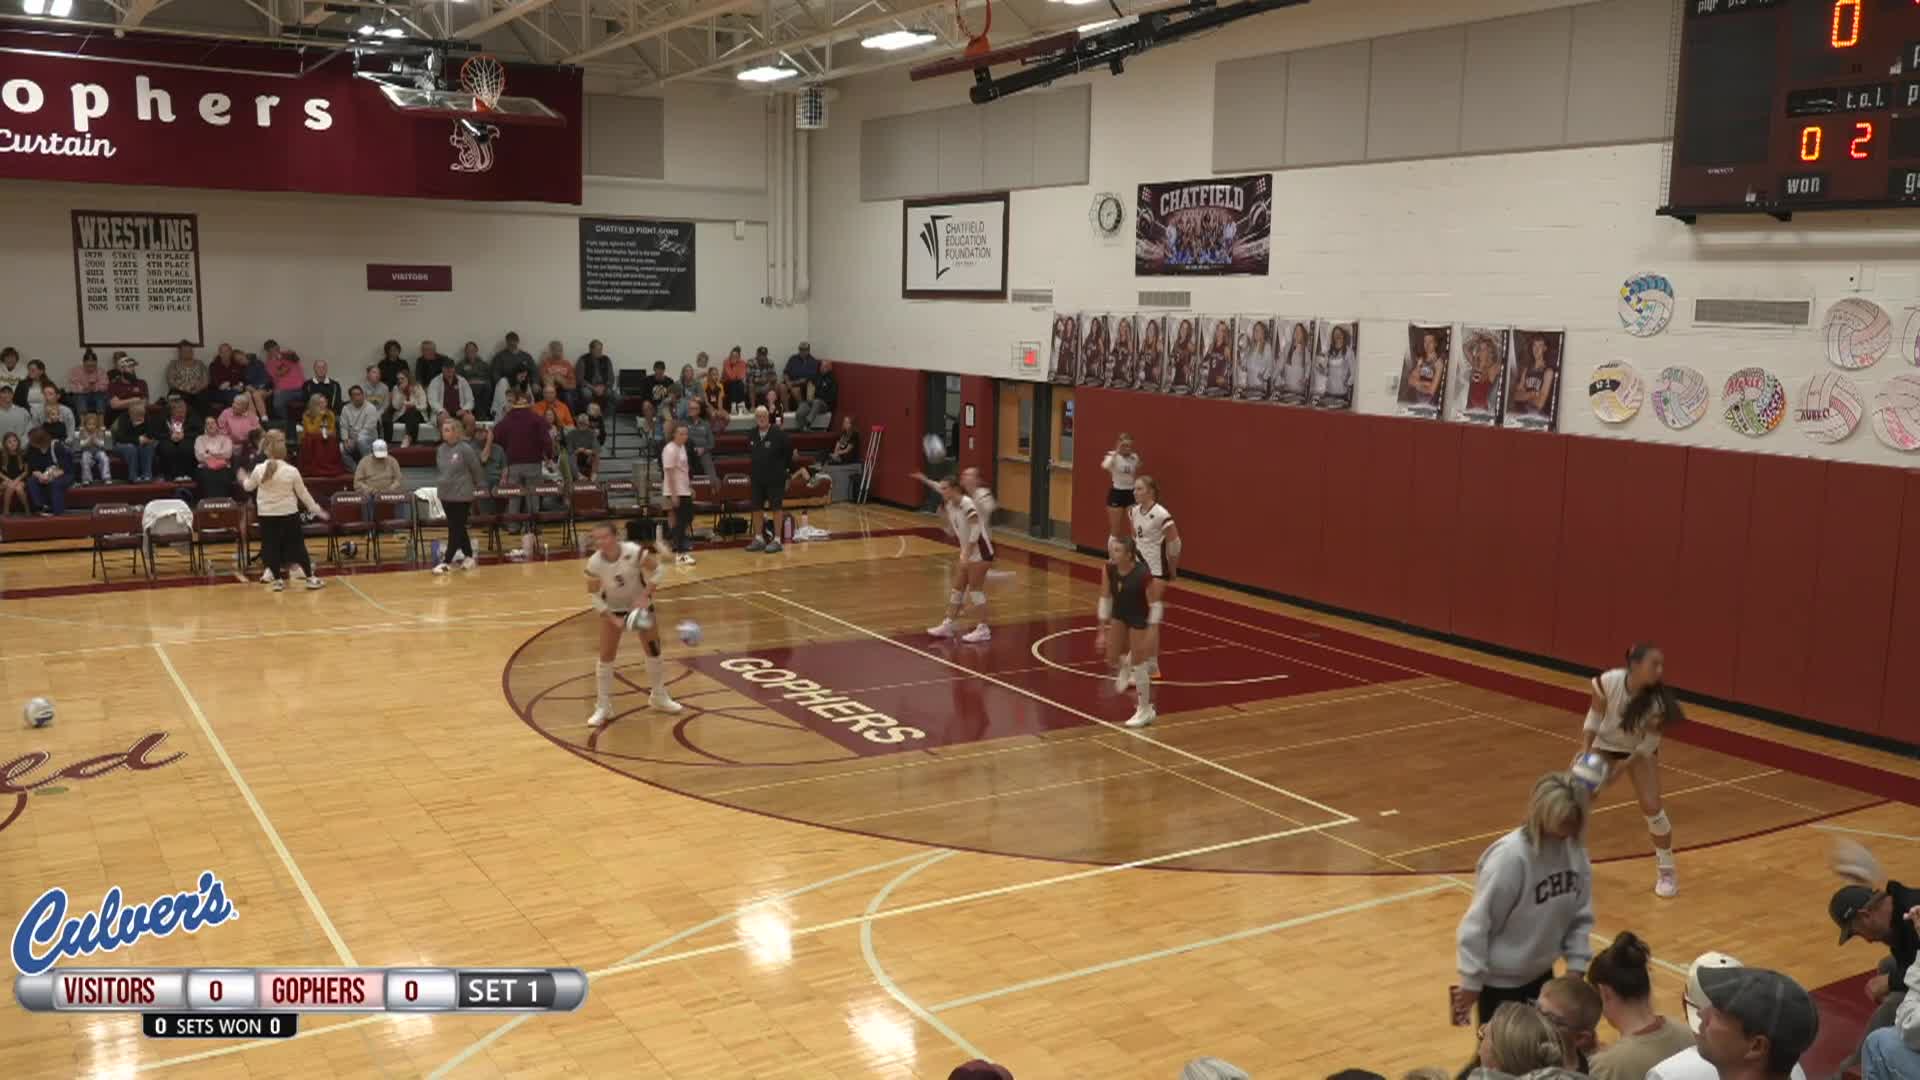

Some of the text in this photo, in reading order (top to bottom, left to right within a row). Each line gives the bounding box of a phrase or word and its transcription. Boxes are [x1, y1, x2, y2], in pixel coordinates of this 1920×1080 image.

[1832, 0, 1860, 47] 0
[1801, 123, 1872, 160] 0 2
[1787, 177, 1820, 194] won
[1160, 184, 1244, 217] CHATFIELD
[78, 216, 193, 250] WRESTLING
[594, 224, 635, 234] CHATFIELD
[945, 221, 985, 234] CHATFIELD
[945, 234, 987, 247] EDUCATION
[945, 247, 991, 260] FOUNDATION
[391, 271, 430, 281] VISITORS
[167, 304, 192, 312] PLACE
[719, 657, 926, 744] GOPHERS
